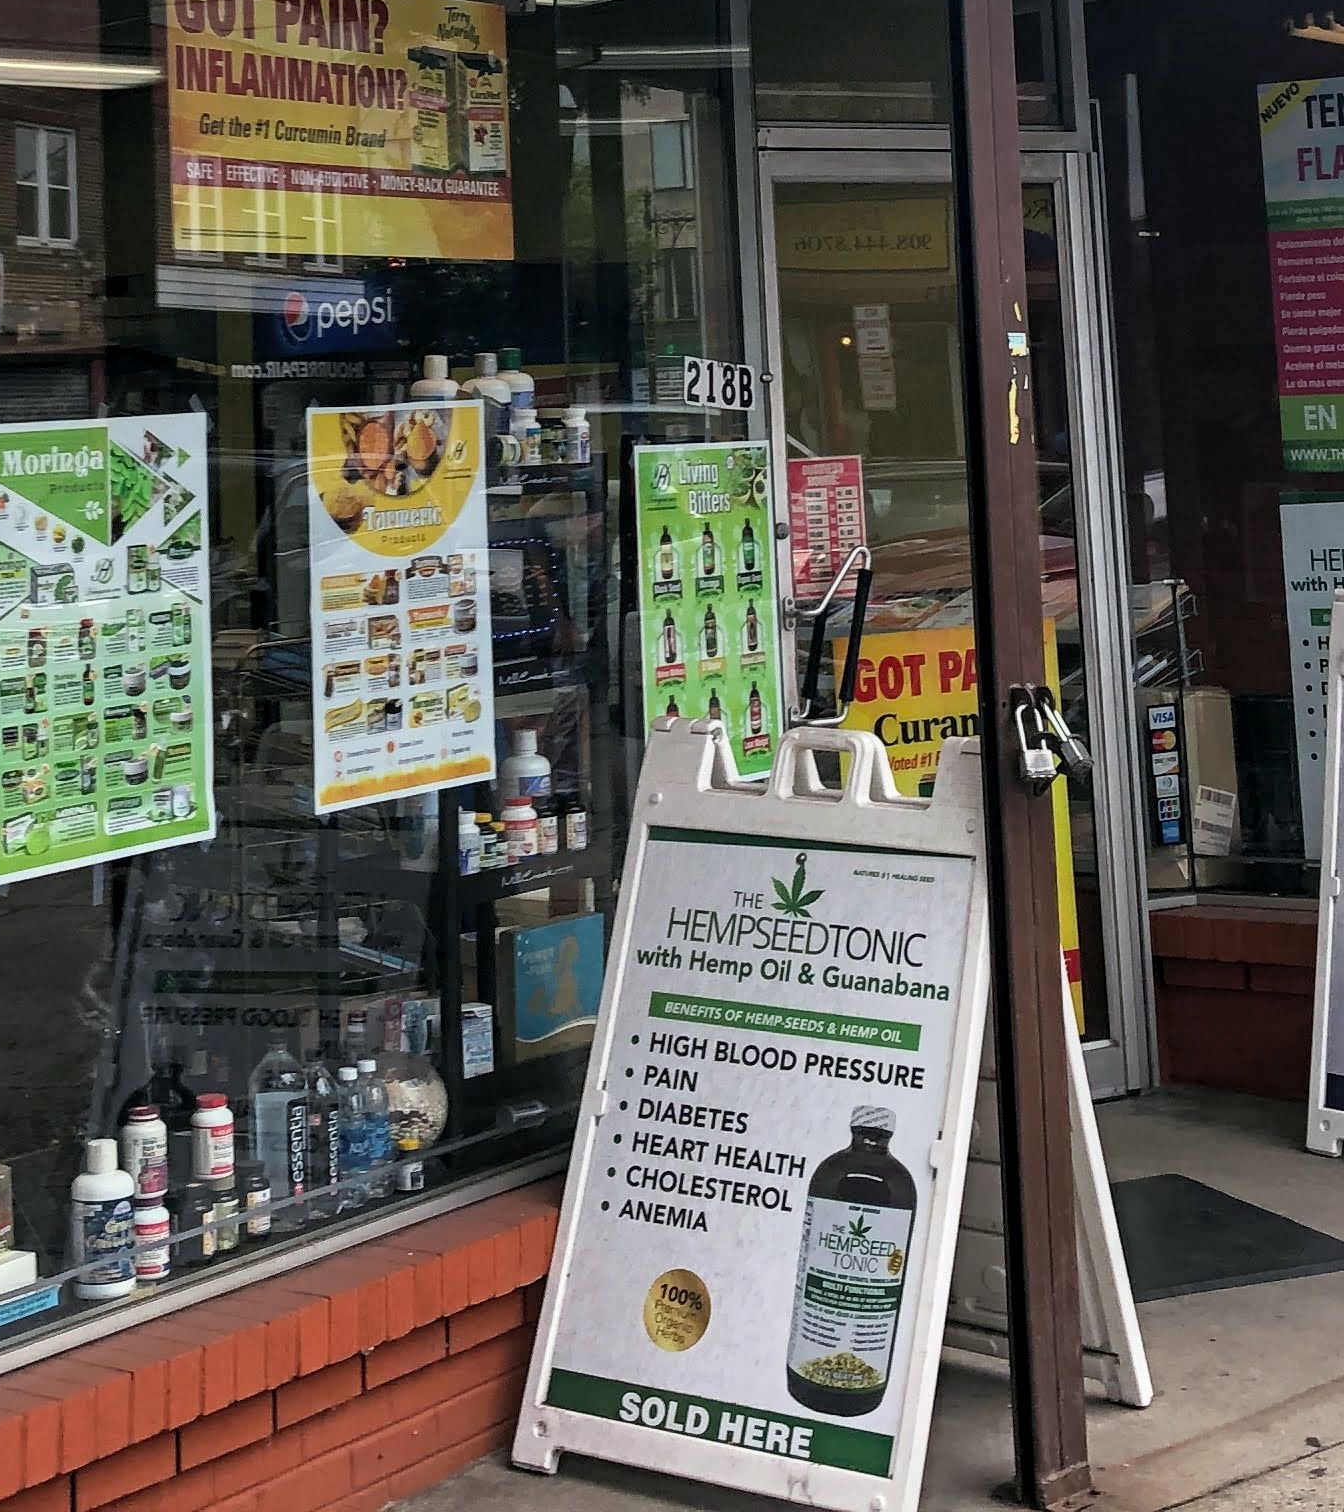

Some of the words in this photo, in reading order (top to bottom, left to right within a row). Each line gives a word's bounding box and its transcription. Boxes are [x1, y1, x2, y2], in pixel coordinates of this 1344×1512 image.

[175, 44, 408, 111] INFLAMMATION?
[1260, 82, 1300, 123] NUEVO
[199, 112, 225, 136] Get
[229, 117, 251, 138] the
[256, 119, 269, 138] #1
[275, 120, 341, 145] Curcumin
[345, 125, 387, 148] Brand
[186, 161, 214, 180] SAFE
[226, 165, 279, 184] EFFECTIVE
[291, 169, 369, 189] NON-ADDICTIVE
[380, 175, 443, 194] MONEY-BACK
[445, 178, 500, 197] GUARANTEE
[317, 288, 392, 338] pepsi
[687, 361, 753, 408] 218B
[1303, 404, 1337, 431] EN
[1, 445, 104, 478] Moringa
[678, 457, 719, 487] Living
[362, 501, 443, 531] Turmeric
[688, 490, 732, 514] Bitters
[381, 533, 427, 544] Products
[1290, 576, 1328, 592] with
[853, 654, 926, 703] GOT
[938, 648, 978, 694] PA
[1151, 712, 1174, 724] VISA
[733, 890, 765, 910] THE
[666, 906, 927, 968] HEMPSEEDTONIC
[636, 945, 682, 970] with
[688, 949, 753, 984] Hemp
[759, 958, 792, 984] Oil
[798, 962, 815, 985] &
[822, 966, 951, 1002] Guanabana
[663, 1001, 723, 1021] BENEFITS
[725, 1007, 743, 1022] OF
[744, 1012, 825, 1034] HEMP-SEEDS
[826, 1022, 838, 1036] &
[840, 1023, 879, 1040] HEMP
[881, 1028, 903, 1044] OIL
[649, 1032, 708, 1060] HIGH
[714, 1041, 798, 1071] BLOOD
[805, 1052, 925, 1089] PRESSURE
[643, 1065, 698, 1093] PAIN
[638, 1098, 750, 1134] DIABETES
[290, 1105, 305, 1183] essentia
[631, 1131, 709, 1163] HEART
[715, 1144, 806, 1179] HEALTH
[626, 1165, 793, 1213] CHOLESTEROL
[618, 1199, 709, 1233] ANEMIA
[818, 1231, 897, 1257] HEMPSEED
[832, 1252, 879, 1274] TONIC
[660, 1283, 703, 1311] 100%
[655, 1312, 693, 1334] Organic
[655, 1324, 685, 1345] Herbs
[619, 1391, 710, 1435] SOLD
[718, 1411, 814, 1459] HERE
